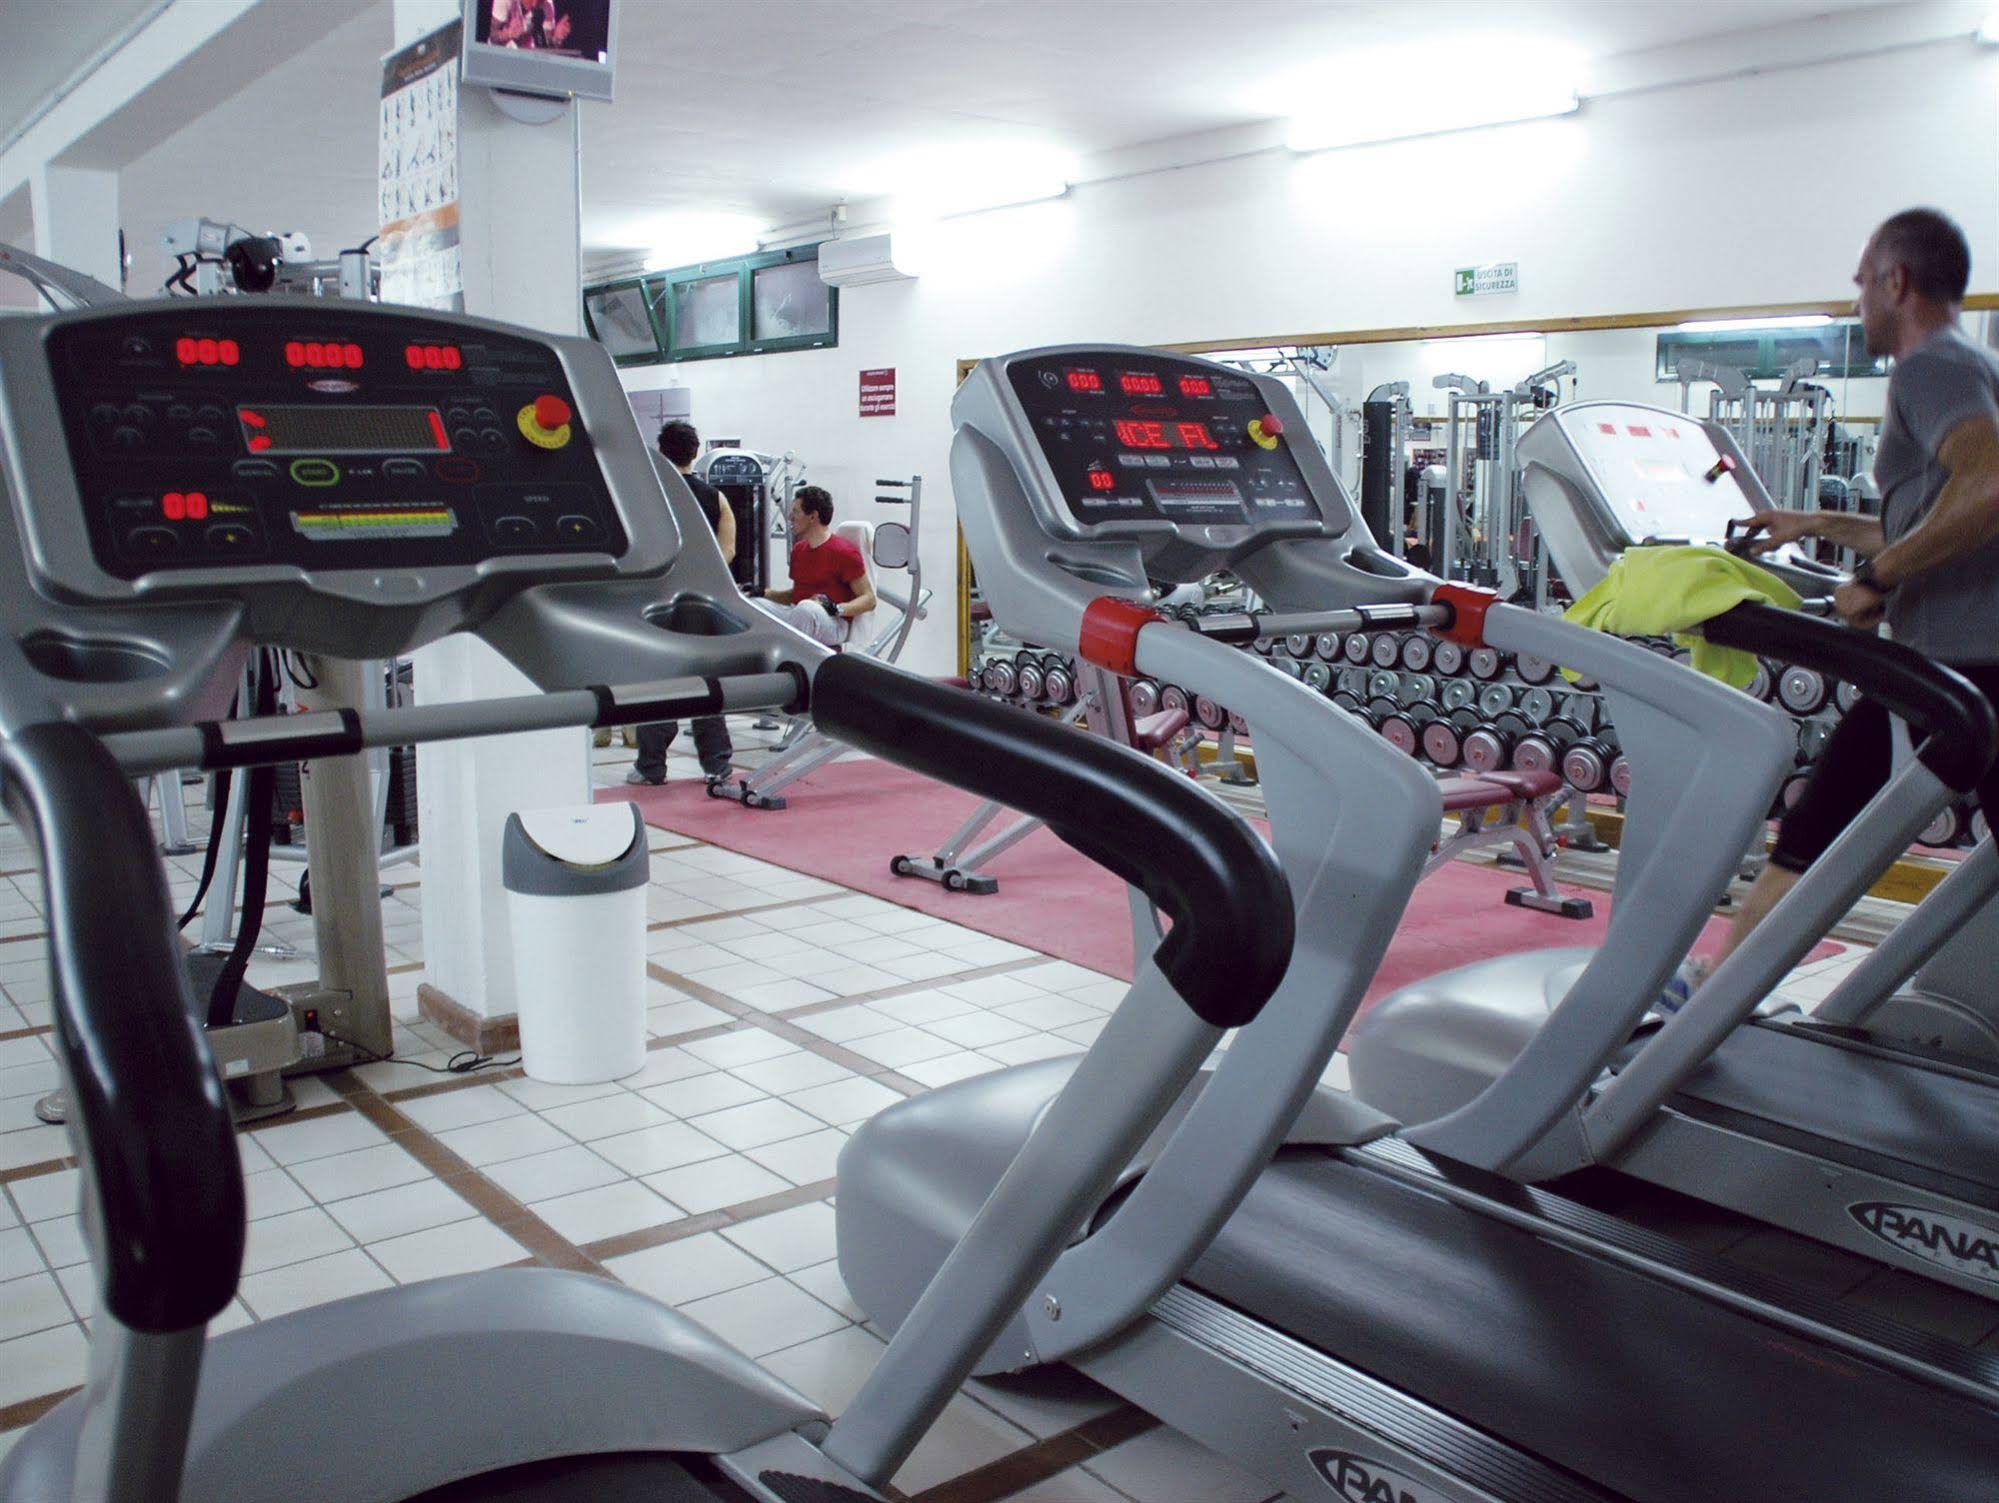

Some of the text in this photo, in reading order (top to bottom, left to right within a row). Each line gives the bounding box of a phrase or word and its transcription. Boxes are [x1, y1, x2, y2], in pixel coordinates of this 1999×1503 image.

[1477, 268, 1513, 279] USCITA DI
[1475, 280, 1515, 291] SICUREZZA
